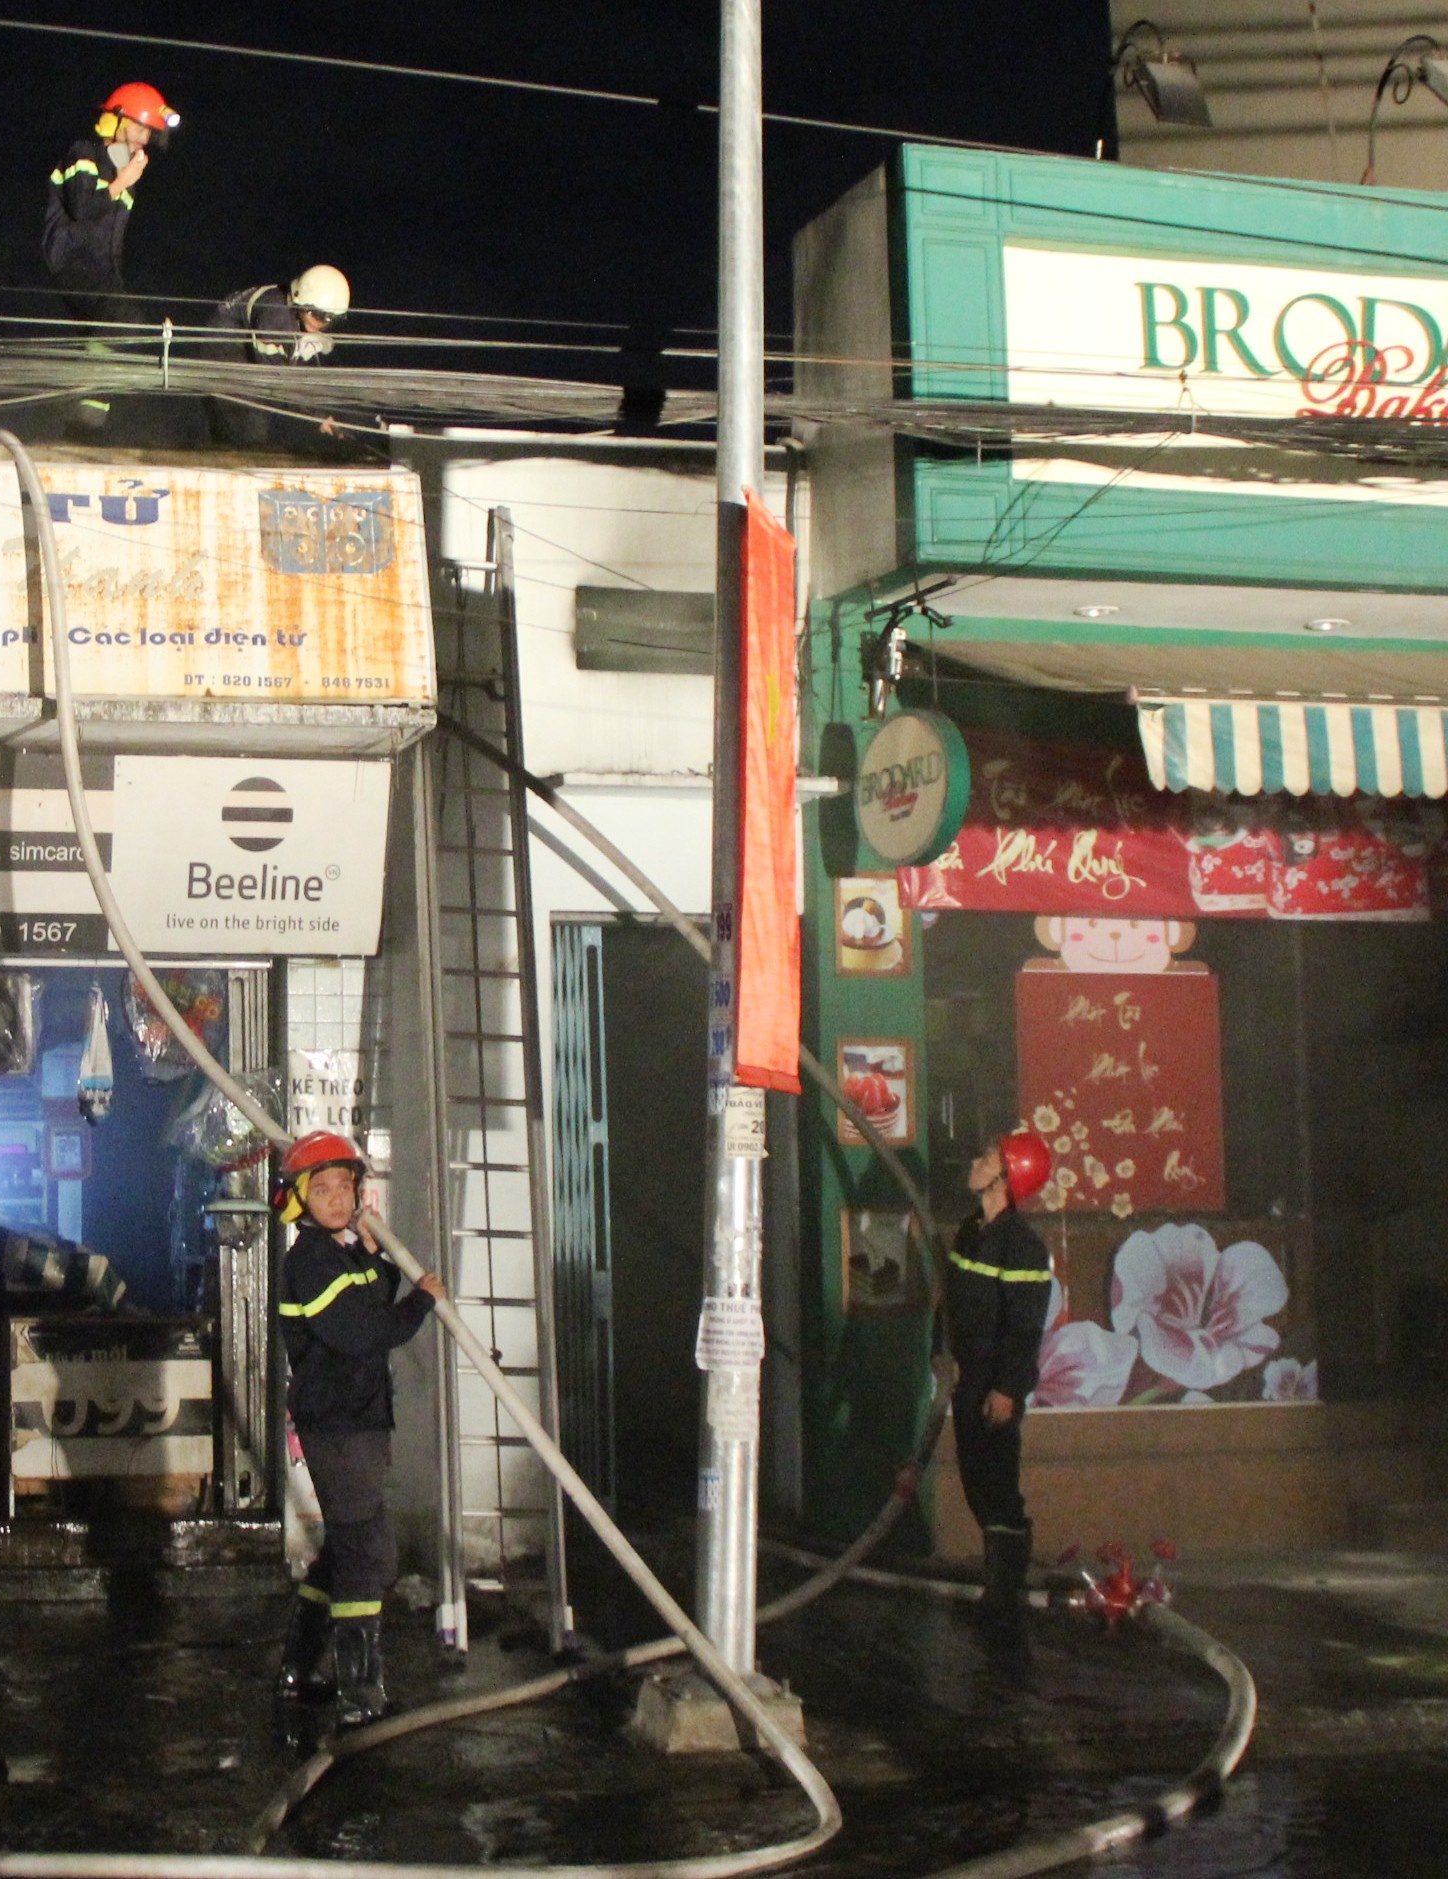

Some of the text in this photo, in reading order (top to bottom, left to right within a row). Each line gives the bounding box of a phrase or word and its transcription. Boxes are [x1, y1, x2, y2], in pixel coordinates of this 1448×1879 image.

[1133, 281, 1448, 387] BROD
[22, 479, 171, 526] TỬ
[68, 624, 131, 646] Các
[140, 627, 195, 653] loại
[204, 627, 267, 653] điện
[222, 675, 252, 687] 820
[257, 676, 293, 689] 1567
[321, 677, 351, 689] 846
[356, 677, 391, 690] 7531
[187, 862, 324, 901] Beeline
[19, 922, 77, 943] 1567
[166, 914, 340, 934] live on the bright side
[319, 1078, 364, 1096] TREO
[294, 1106, 316, 1126] TV
